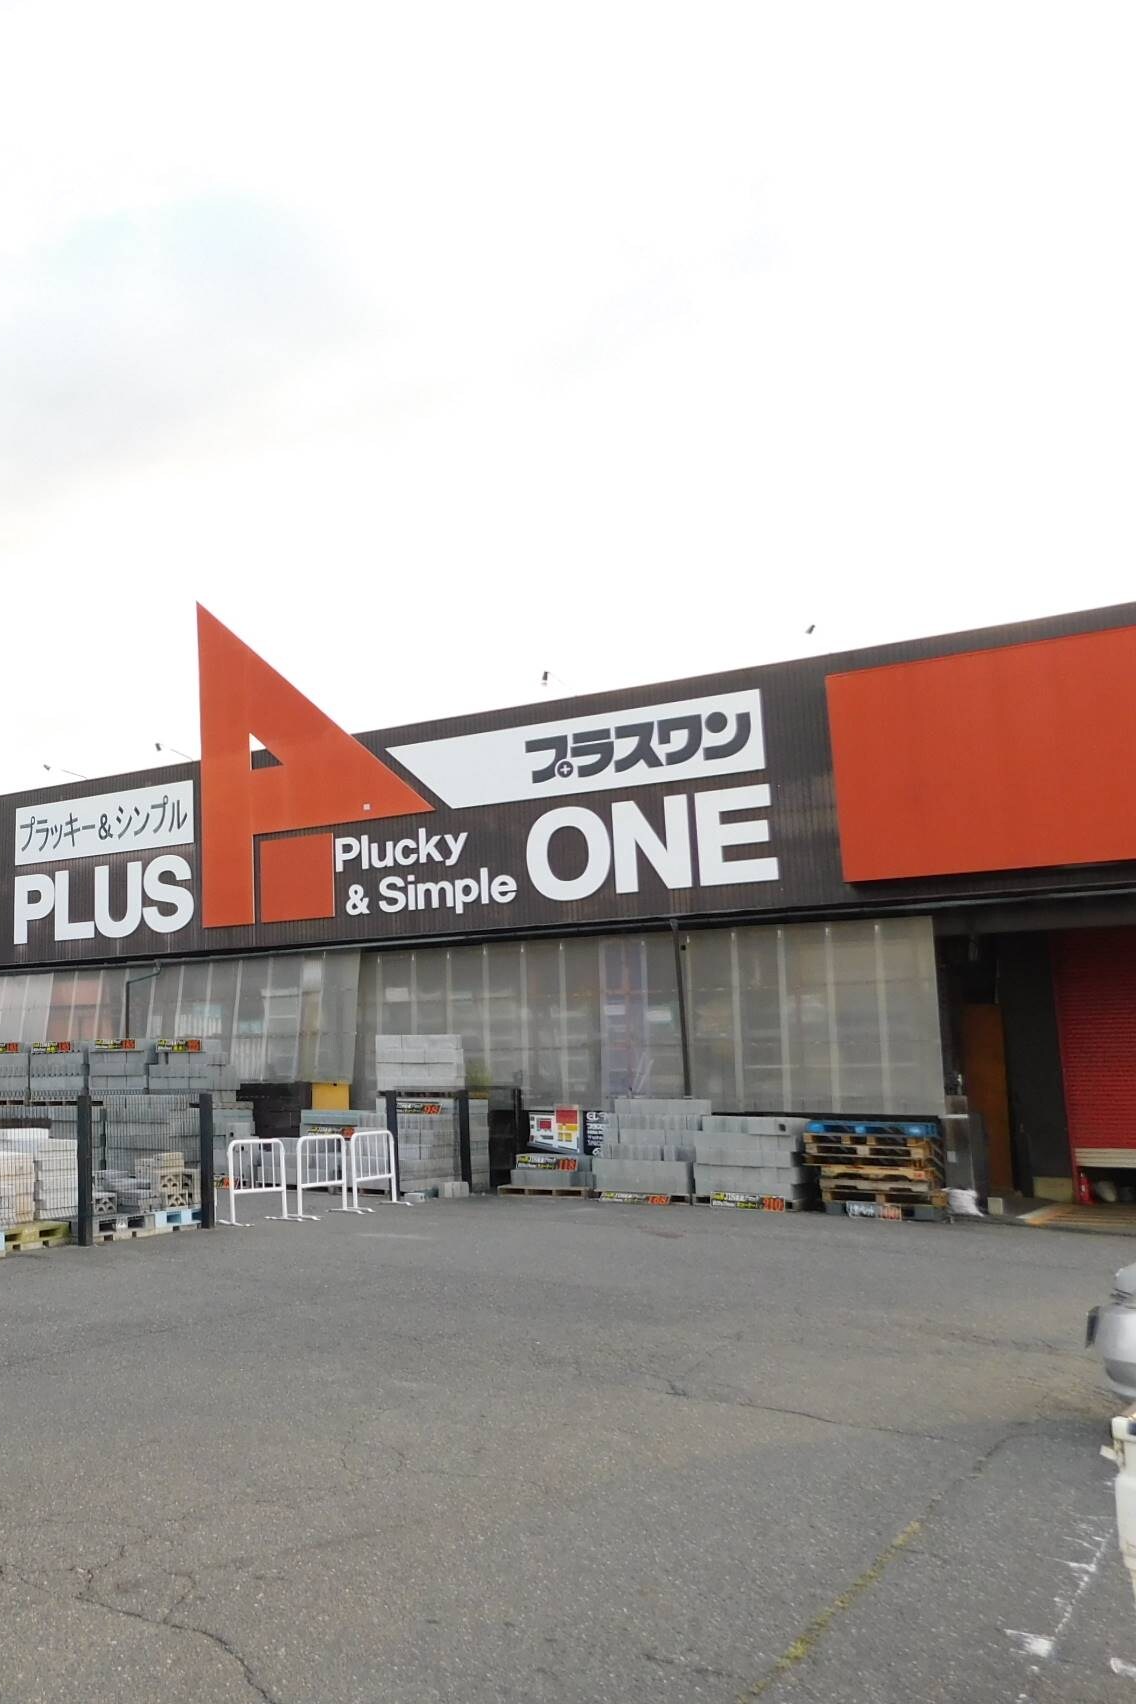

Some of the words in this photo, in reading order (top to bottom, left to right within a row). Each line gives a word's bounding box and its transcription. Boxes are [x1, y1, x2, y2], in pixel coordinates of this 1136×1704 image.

[525, 711, 752, 784] プラスワン
[20, 795, 188, 853] プラッキー&シンプル
[334, 828, 468, 873] Plucky
[525, 783, 780, 902] ONE
[13, 854, 194, 945] PLUS
[346, 883, 370, 916] &
[378, 868, 518, 917] Simple
